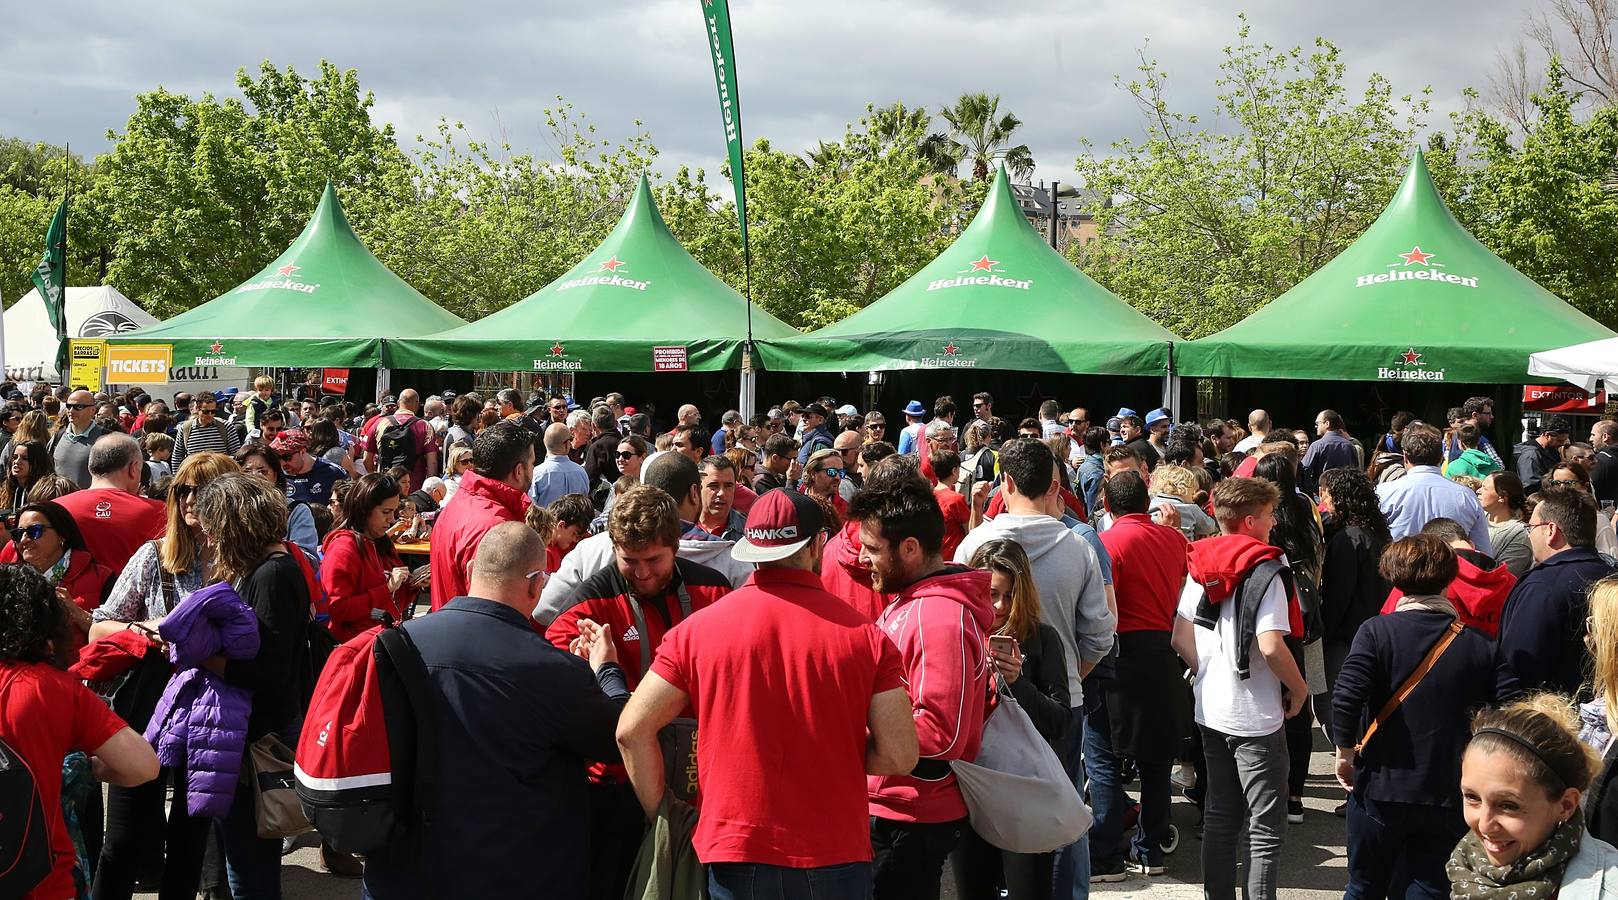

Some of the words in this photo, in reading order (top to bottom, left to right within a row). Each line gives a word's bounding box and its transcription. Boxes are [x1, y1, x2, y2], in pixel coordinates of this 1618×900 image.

[709, 14, 737, 143] Heineken
[556, 274, 648, 291] Heineken
[927, 274, 1032, 291] Heineken
[1355, 268, 1479, 288] Heineken
[111, 359, 166, 373] TICKETS
[194, 356, 236, 366] Heineken
[533, 359, 582, 370] Heineken
[920, 357, 976, 368] Heineken
[1377, 367, 1444, 380] Heineken
[1531, 390, 1583, 400] EXTINTOR
[745, 528, 782, 540] HAWK
